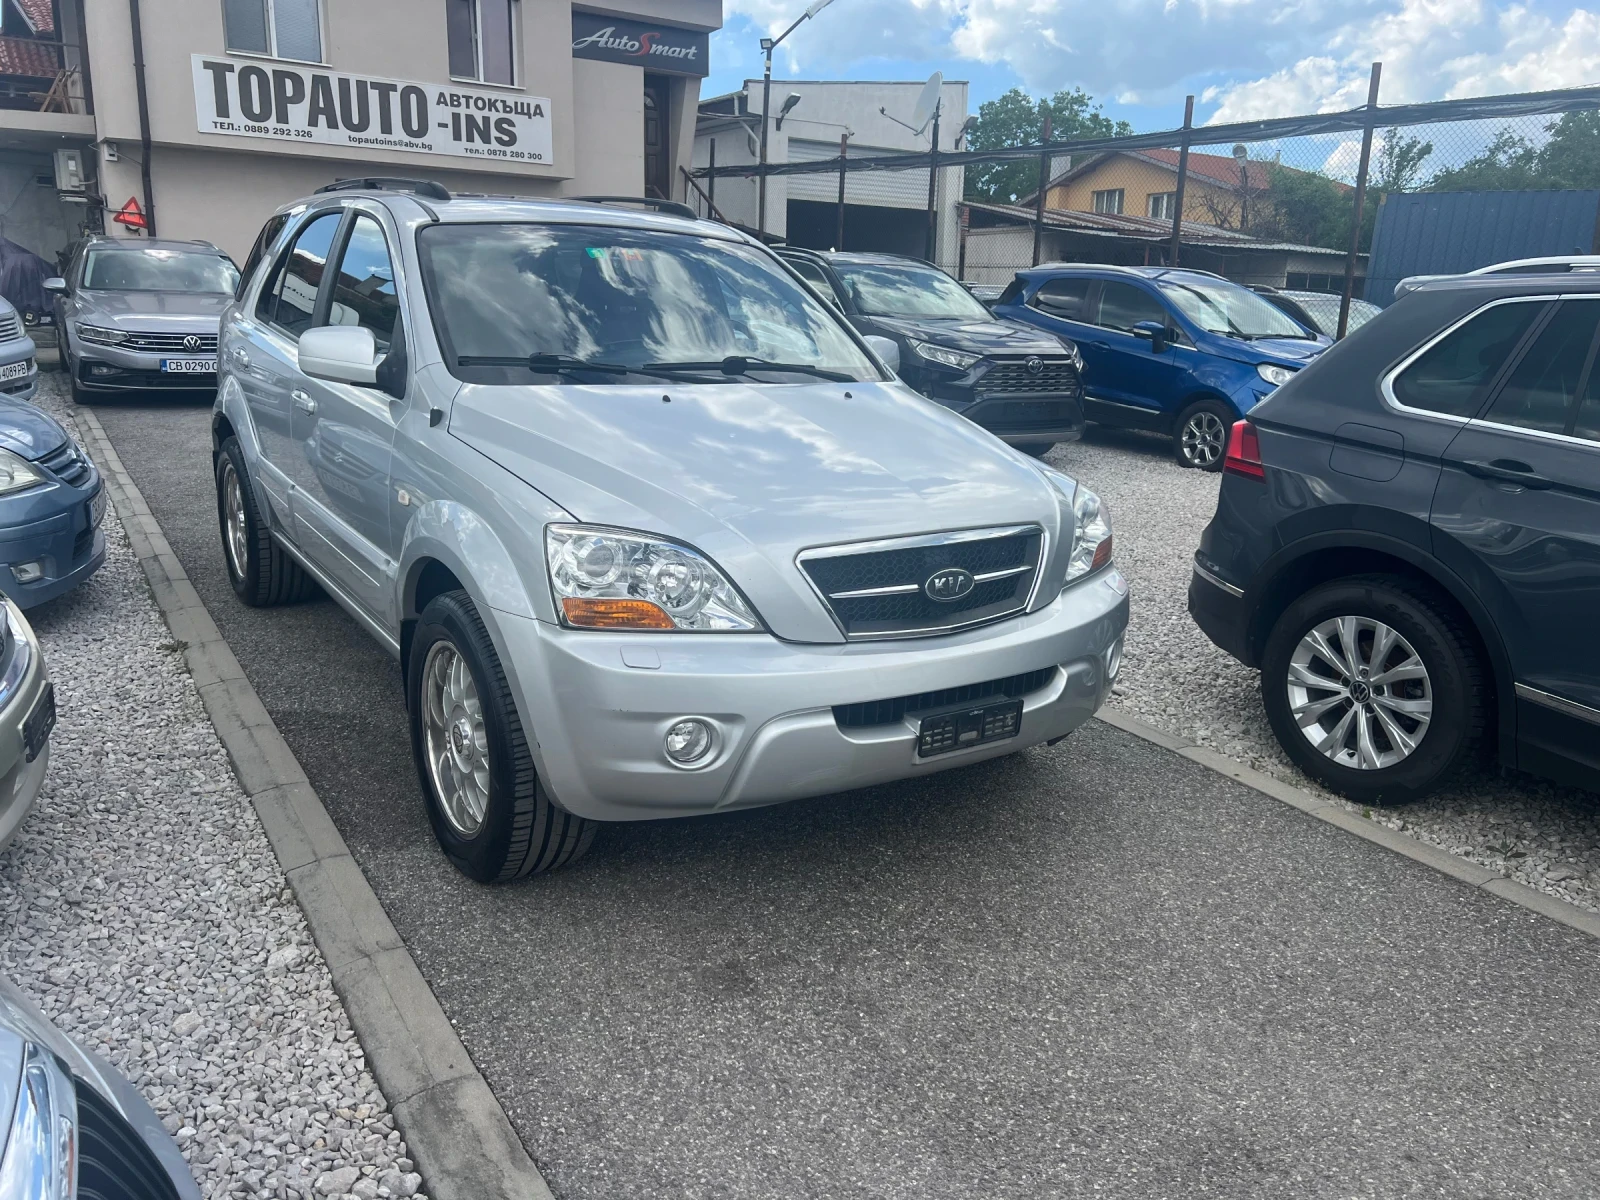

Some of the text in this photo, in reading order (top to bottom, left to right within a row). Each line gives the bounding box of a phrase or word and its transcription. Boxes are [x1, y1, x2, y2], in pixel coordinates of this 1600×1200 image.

[202, 60, 430, 138] TOPAUTO
[436, 91, 545, 119] АВТОКЪЩА
[212, 120, 313, 139] ТЕЛ.: 0889 292 326
[348, 135, 433, 151] topautoins@abv.bg
[463, 147, 543, 161] тел.: 0878 280 300
[168, 361, 183, 371] CB
[184, 361, 210, 371] 0290
[933, 575, 967, 595] KIA
